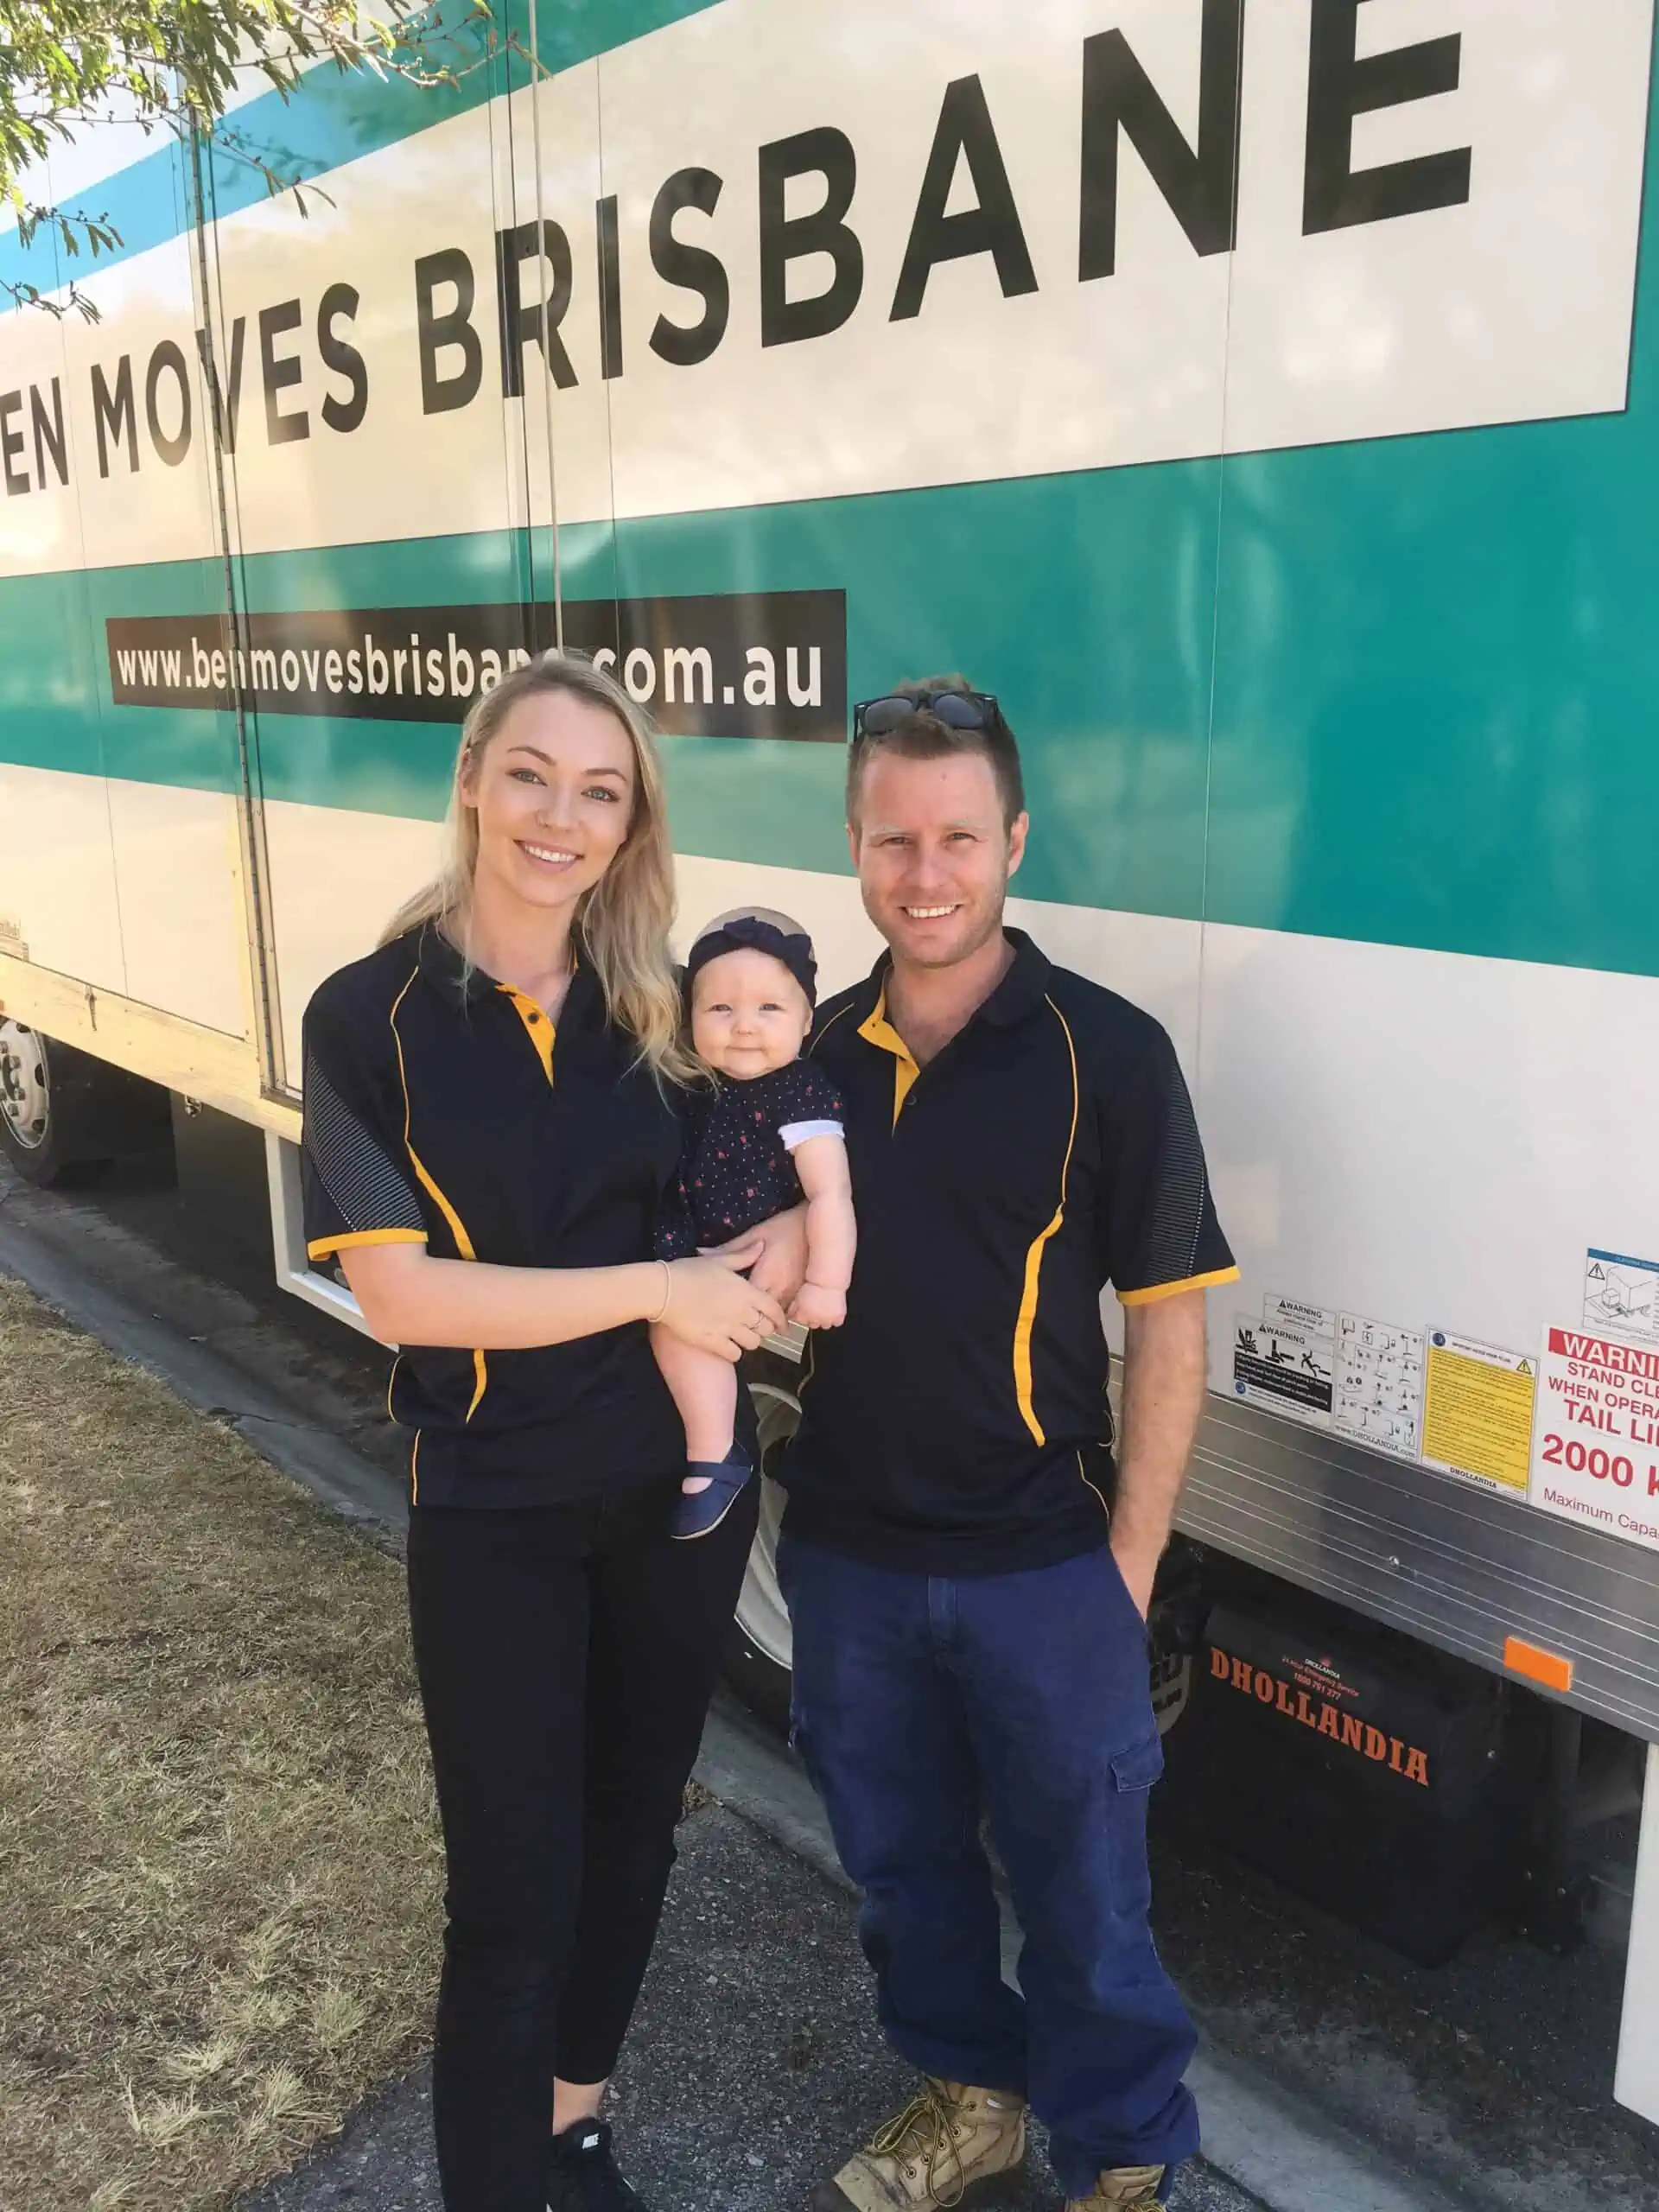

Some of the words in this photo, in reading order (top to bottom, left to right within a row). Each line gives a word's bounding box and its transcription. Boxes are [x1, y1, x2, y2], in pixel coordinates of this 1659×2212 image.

[0, 390, 69, 497] EN
[90, 283, 369, 480] MOVES
[415, 0, 1472, 416] BRISBANE
[1287, 1301, 1322, 1319] WARNING
[1267, 1326, 1306, 1344] WARNING
[1563, 1333, 1659, 1380] WARNI
[1548, 1376, 1599, 1403] WHEN
[1567, 1362, 1624, 1389] STAND
[1564, 1399, 1621, 1435] TAIL
[1450, 1467, 1497, 1488] DHOLLANDIA
[1542, 1433, 1633, 1487] 2000
[1544, 1487, 1613, 1522] Maximum
[1618, 1514, 1659, 1541] Capa
[1210, 1646, 1429, 1787] DHOLLANDIA
